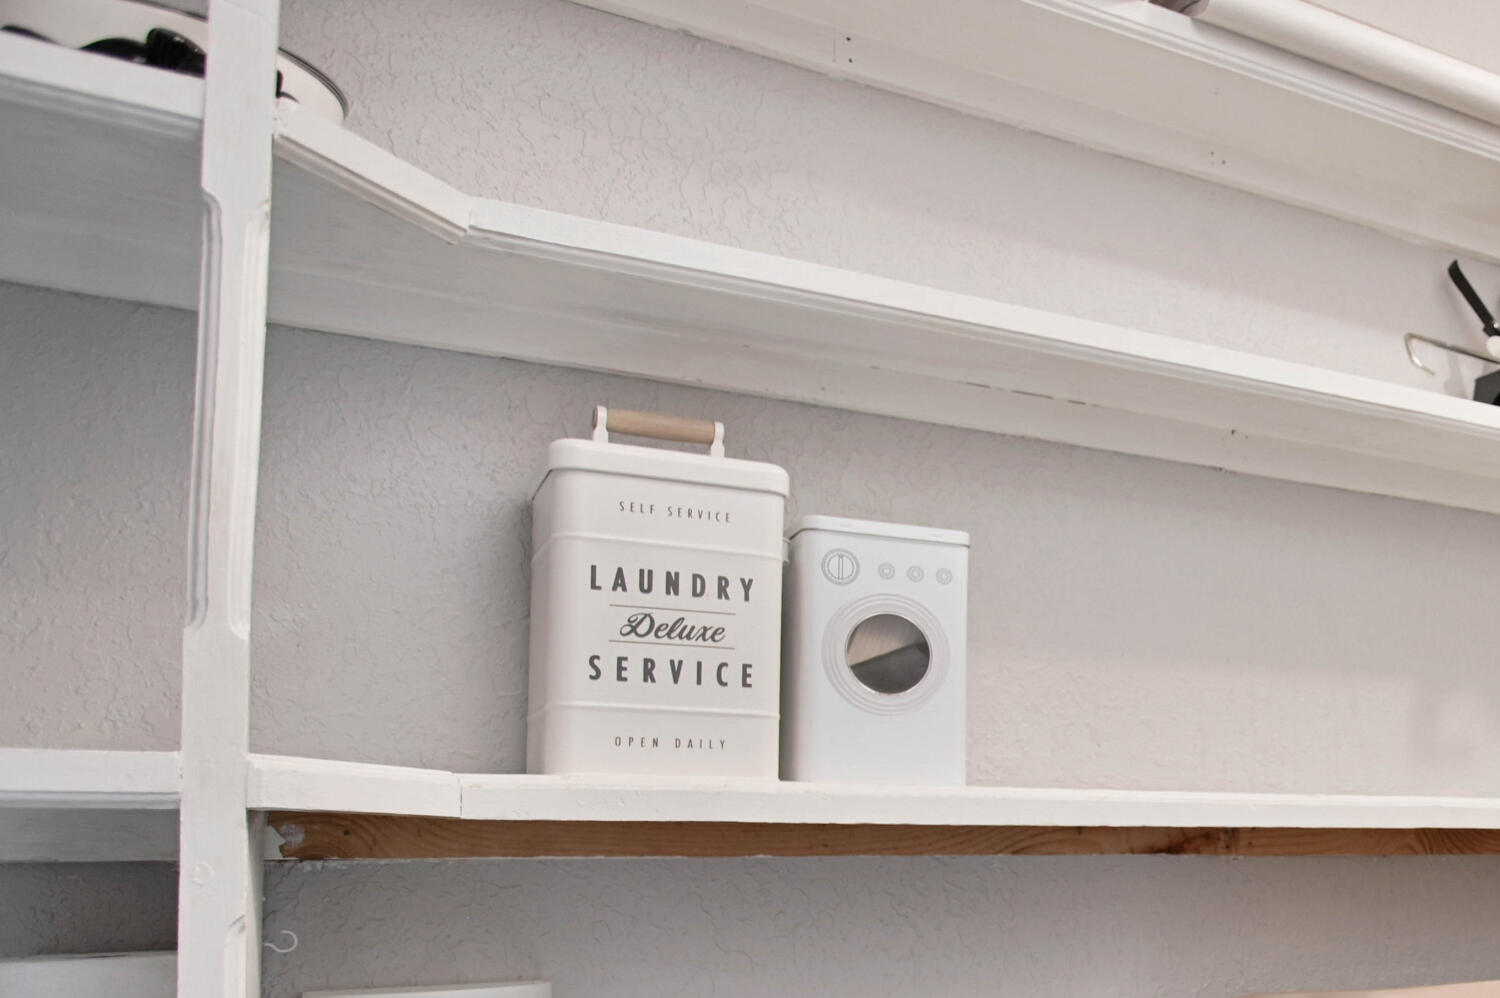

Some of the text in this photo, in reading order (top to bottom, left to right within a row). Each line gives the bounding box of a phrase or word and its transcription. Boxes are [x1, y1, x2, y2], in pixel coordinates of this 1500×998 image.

[619, 501, 732, 522] SELF SERVICE
[590, 564, 754, 602] LAUNDRY
[619, 612, 726, 643] Deluxe
[588, 655, 753, 688] SERVICE
[614, 736, 726, 750] OPEN DAILY
